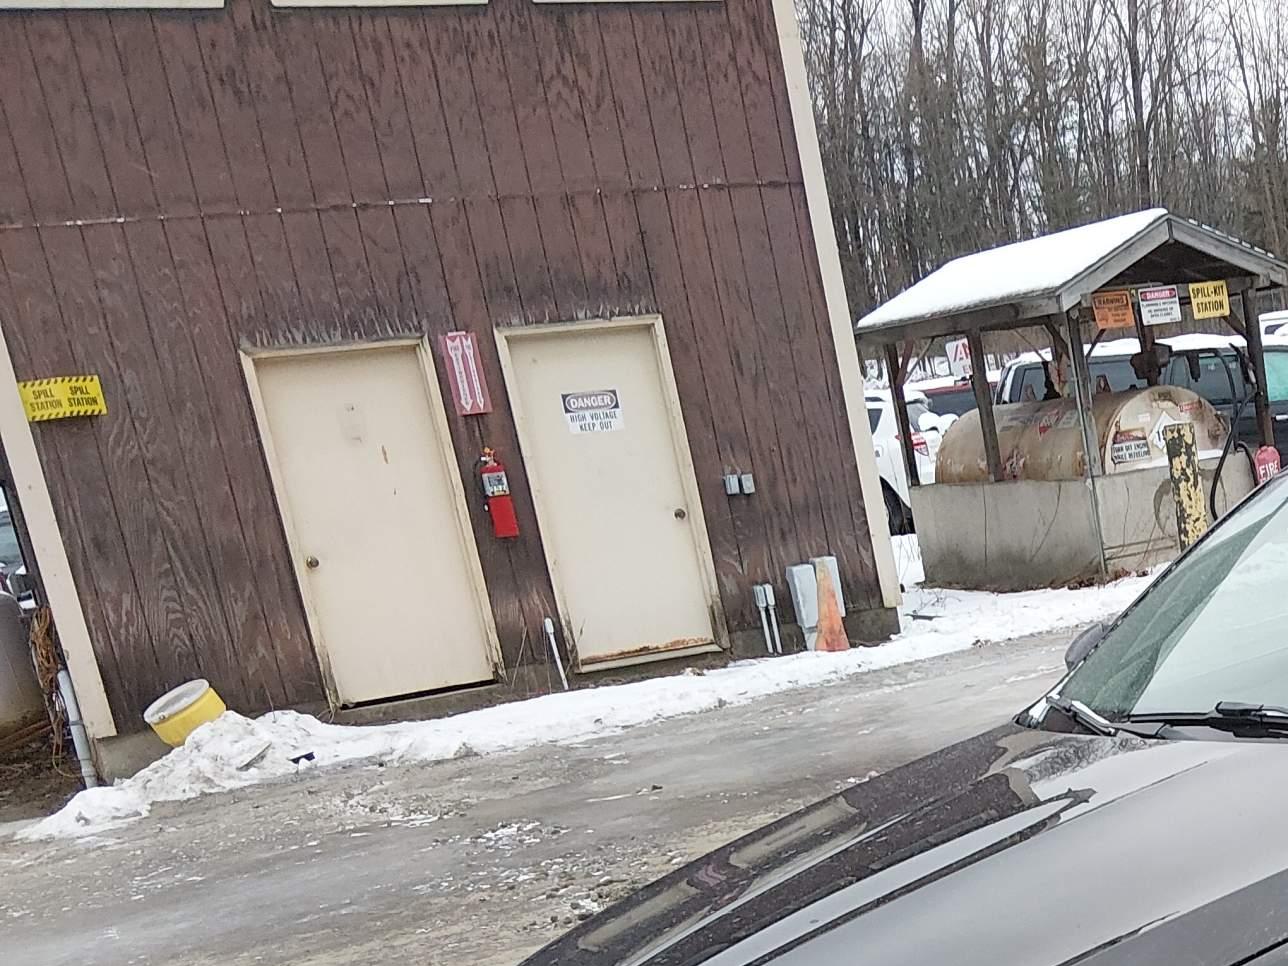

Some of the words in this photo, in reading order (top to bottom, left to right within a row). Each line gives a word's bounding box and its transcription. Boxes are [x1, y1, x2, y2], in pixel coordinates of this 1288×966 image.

[1191, 284, 1225, 299] SPILL-KIT
[1196, 299, 1225, 313] STATION
[32, 387, 55, 400] SPILL
[69, 385, 91, 396] SPILL
[30, 399, 63, 412] STATION
[67, 396, 99, 408] STATION
[570, 395, 611, 409] DANGER
[569, 413, 587, 423] HIGH
[589, 410, 617, 422] VOLTAGE
[579, 422, 596, 432] KEEP
[600, 421, 613, 430] OUT
[1259, 460, 1279, 481] FIRE
